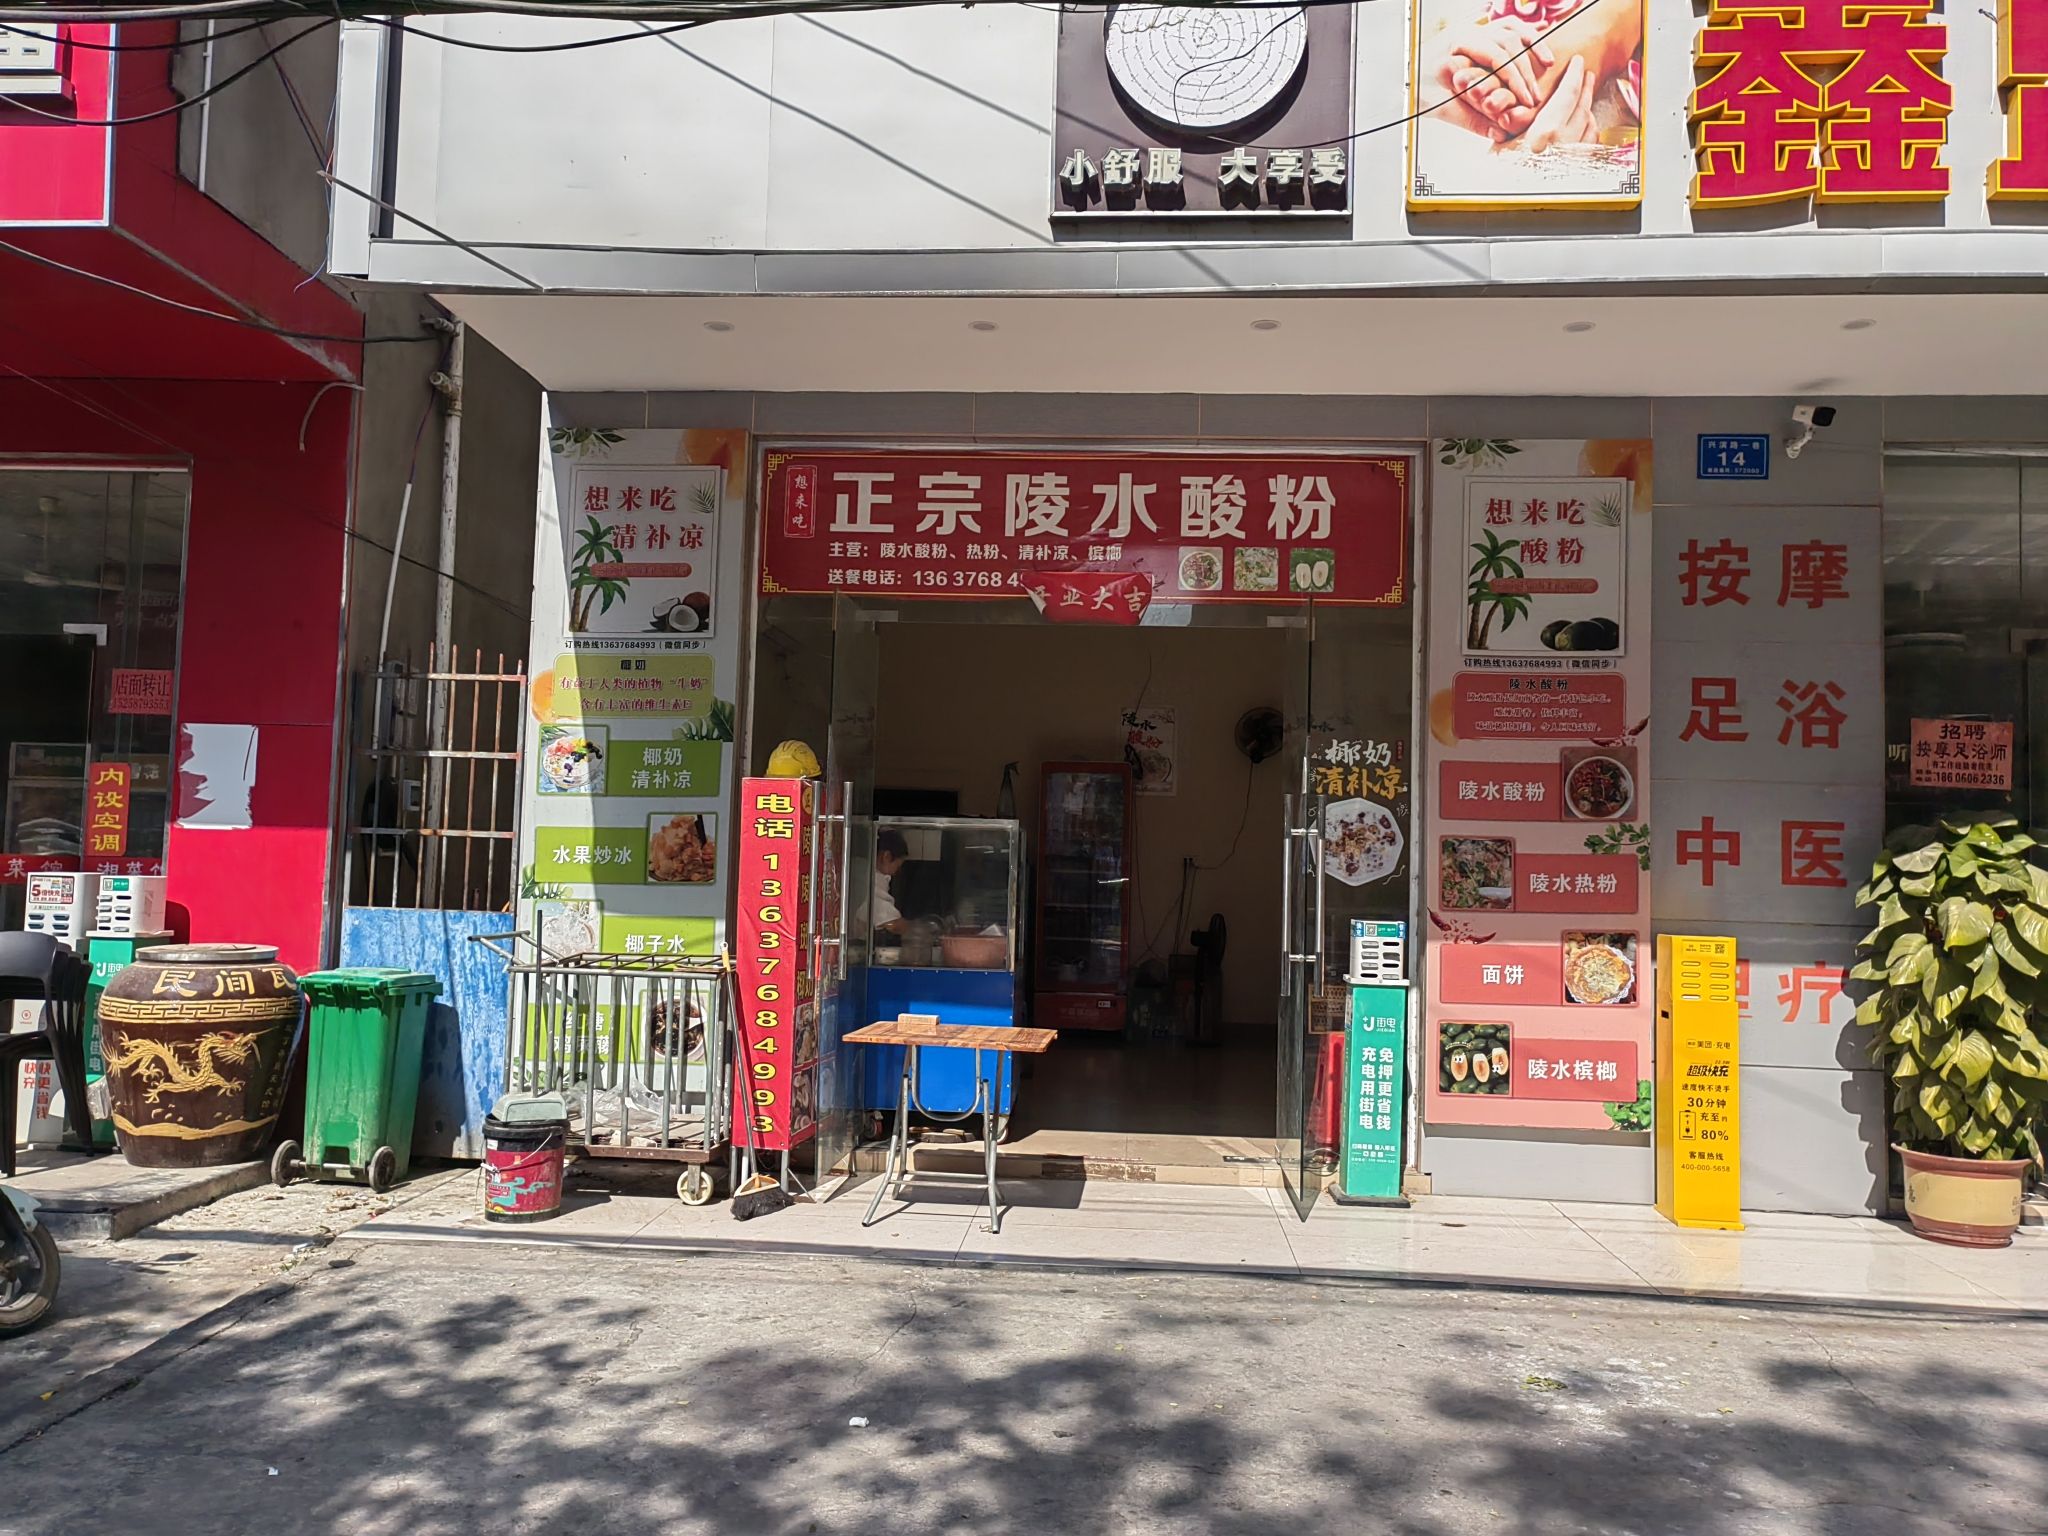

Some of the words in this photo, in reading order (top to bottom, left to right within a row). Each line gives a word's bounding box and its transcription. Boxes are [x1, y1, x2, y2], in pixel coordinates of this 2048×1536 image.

[1059, 147, 1184, 186] 小舒服
[1218, 147, 1347, 186] 大享受
[1717, 451, 1746, 467] 14
[584, 486, 677, 512] 想来吃
[792, 473, 808, 529] 想来吃
[829, 471, 1336, 540] 正宗陵水酸粉
[1485, 498, 1585, 525] 想来吃
[612, 523, 704, 550] 清补凉
[1519, 537, 1585, 565] 酸粉
[1678, 538, 1850, 609] 按摩
[115, 674, 170, 697] 店面转让
[1509, 679, 1569, 690] 陵水酸粉
[1678, 677, 1848, 748] 足浴
[1939, 723, 1986, 741] 招聘
[642, 747, 683, 766] 椰奶
[1325, 738, 1391, 767] 椰奶
[1916, 740, 2008, 761] 按摩足浴师
[631, 769, 692, 789] 清补凉
[1316, 766, 1404, 800] 清补凉
[1459, 781, 1545, 801] 陵水酸粉
[90, 768, 124, 851] 内设空调
[552, 845, 632, 865] 水果炒冰
[1676, 816, 1848, 888] 中医
[1529, 873, 1618, 893] 陵水热粉
[625, 934, 686, 954] 椰子水
[1482, 964, 1525, 985] 面饼
[1528, 1058, 1617, 1082] 陵水槟榔
[1686, 1064, 1729, 1077] 超级快充
[1359, 1047, 1376, 1130] 充电用街电
[1376, 1047, 1394, 1131] 免押更省钱
[1681, 1083, 1731, 1093] 速度快不烫手
[1687, 1097, 1727, 1109] 30分钟
[1701, 1130, 1729, 1141] 80%
[1688, 1151, 1724, 1161] 客服热线
